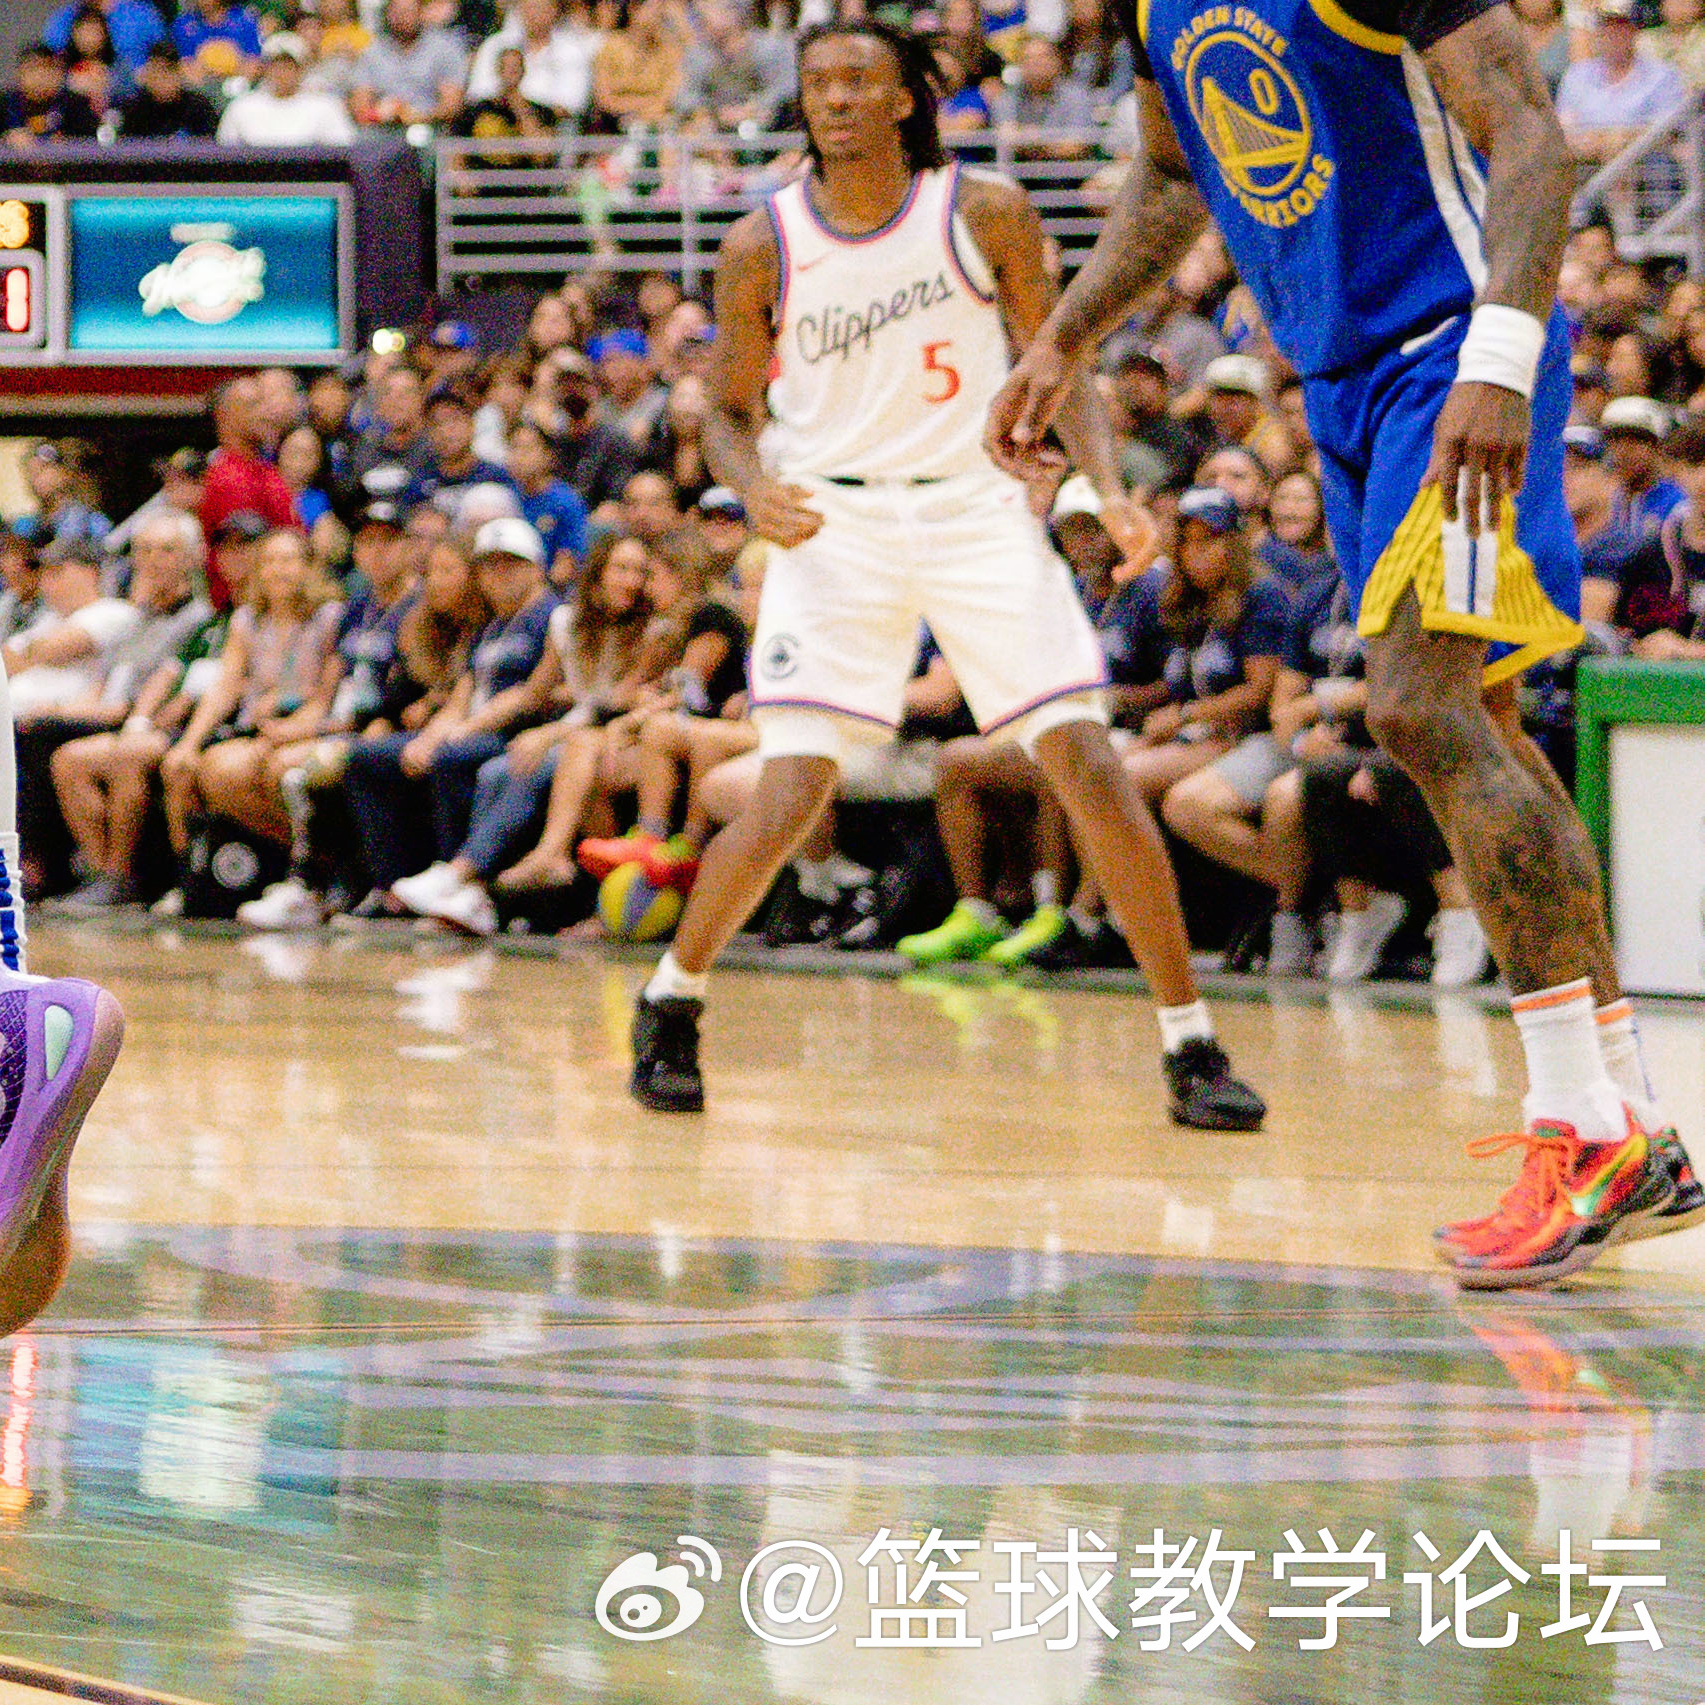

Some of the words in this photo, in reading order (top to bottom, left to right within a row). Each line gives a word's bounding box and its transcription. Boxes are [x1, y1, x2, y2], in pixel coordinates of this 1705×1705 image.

[1170, 5, 1230, 70] GOLDEN
[1234, 6, 1290, 57] STATE
[1248, 68, 1281, 115] 0
[797, 271, 957, 364] Clippers
[921, 340, 961, 404] 5
